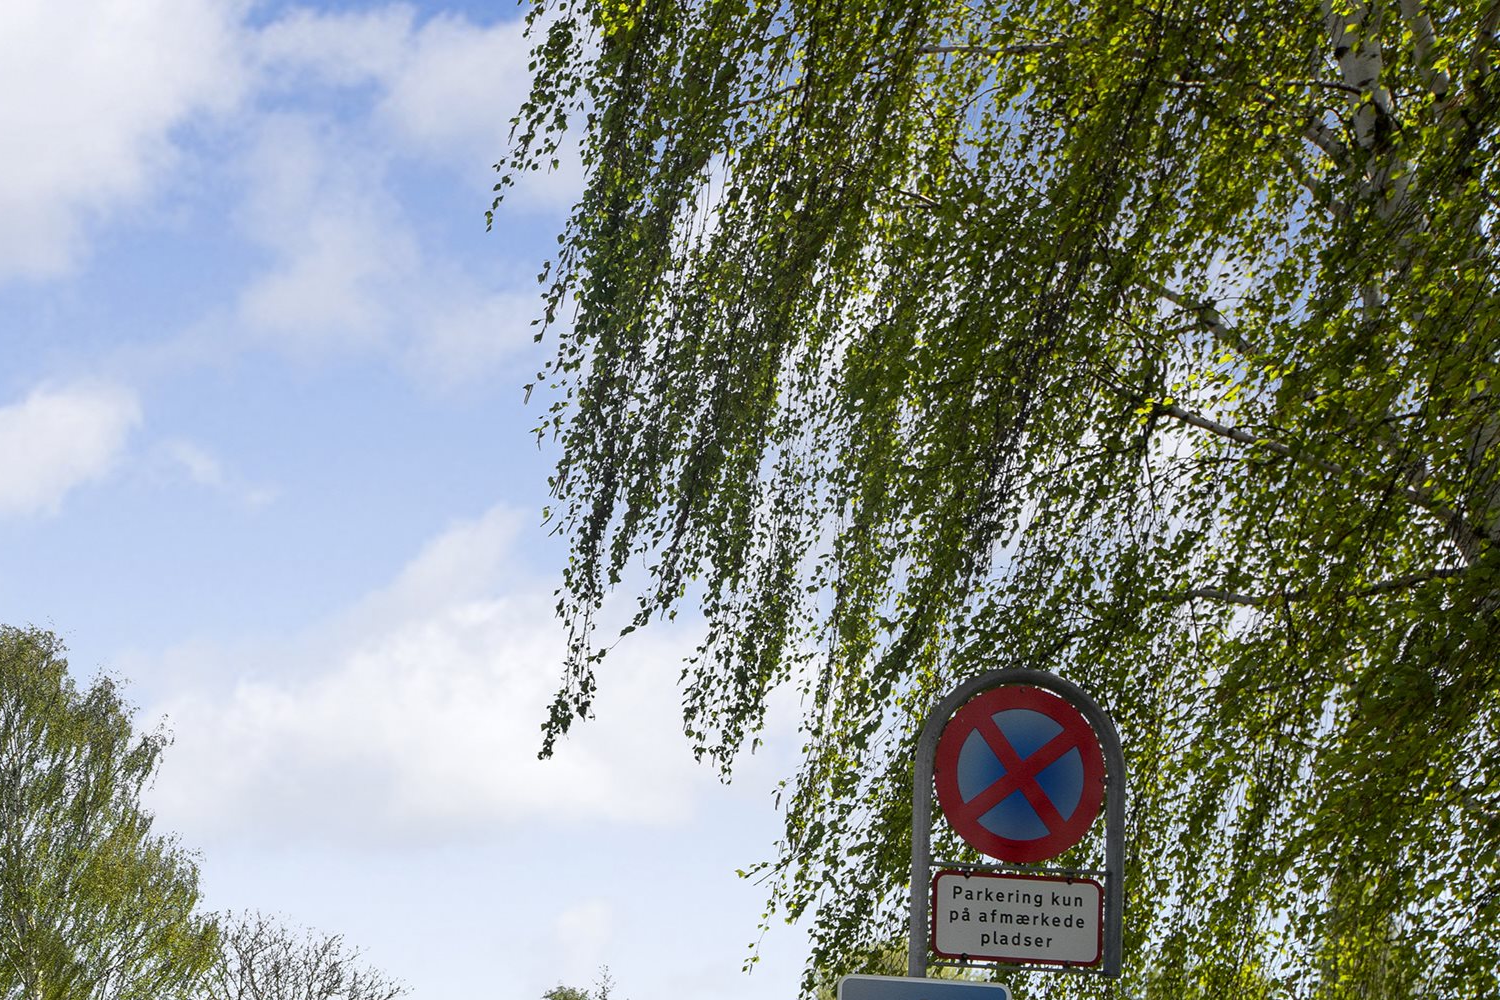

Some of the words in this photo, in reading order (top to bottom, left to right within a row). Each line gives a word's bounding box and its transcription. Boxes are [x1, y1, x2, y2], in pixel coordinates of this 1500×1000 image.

[953, 886, 1042, 907] Parkering
[1052, 892, 1082, 907] kun
[950, 908, 970, 923] på
[979, 909, 1084, 928] afmærkede
[981, 931, 1052, 947] pladser
